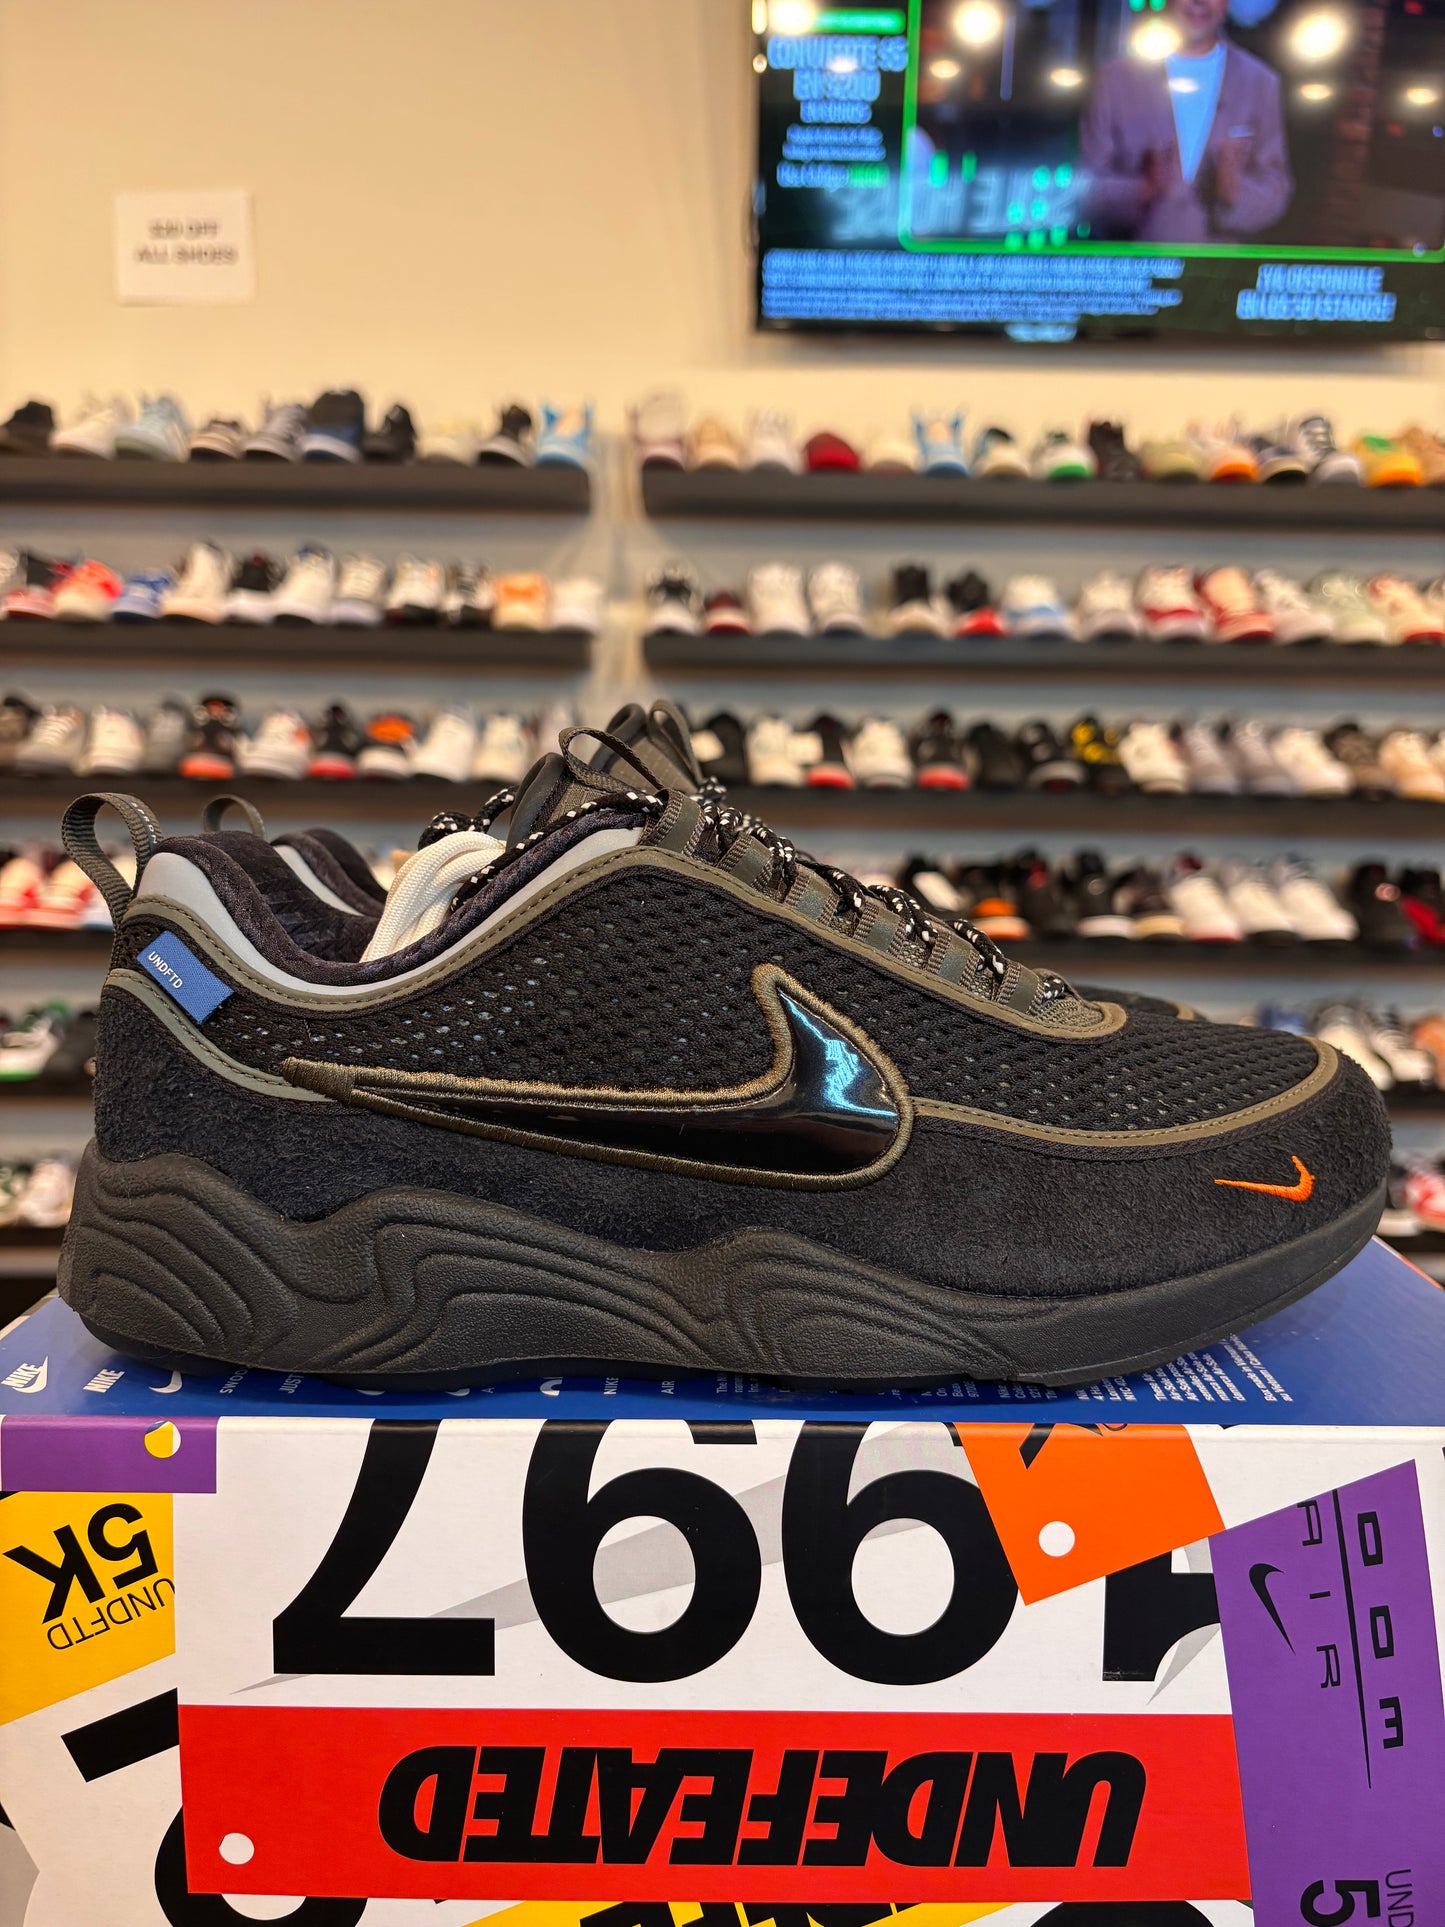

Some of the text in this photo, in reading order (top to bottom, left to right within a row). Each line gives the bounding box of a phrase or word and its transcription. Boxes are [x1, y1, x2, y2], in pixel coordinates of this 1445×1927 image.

[173, 242, 239, 265] SHOES
[148, 951, 183, 989] UNDFTD
[1, 1363, 42, 1388] NIKE
[83, 1369, 125, 1393] NIKE
[279, 1374, 305, 1394] JUST
[1247, 1372, 1266, 1389] made
[1261, 1389, 1278, 1401] Box
[2, 1503, 159, 1625] 5K
[1297, 1500, 1341, 1688] AIR
[47, 1577, 175, 1650] UNDFTD
[378, 1745, 1147, 1868] UNDEFEATED
